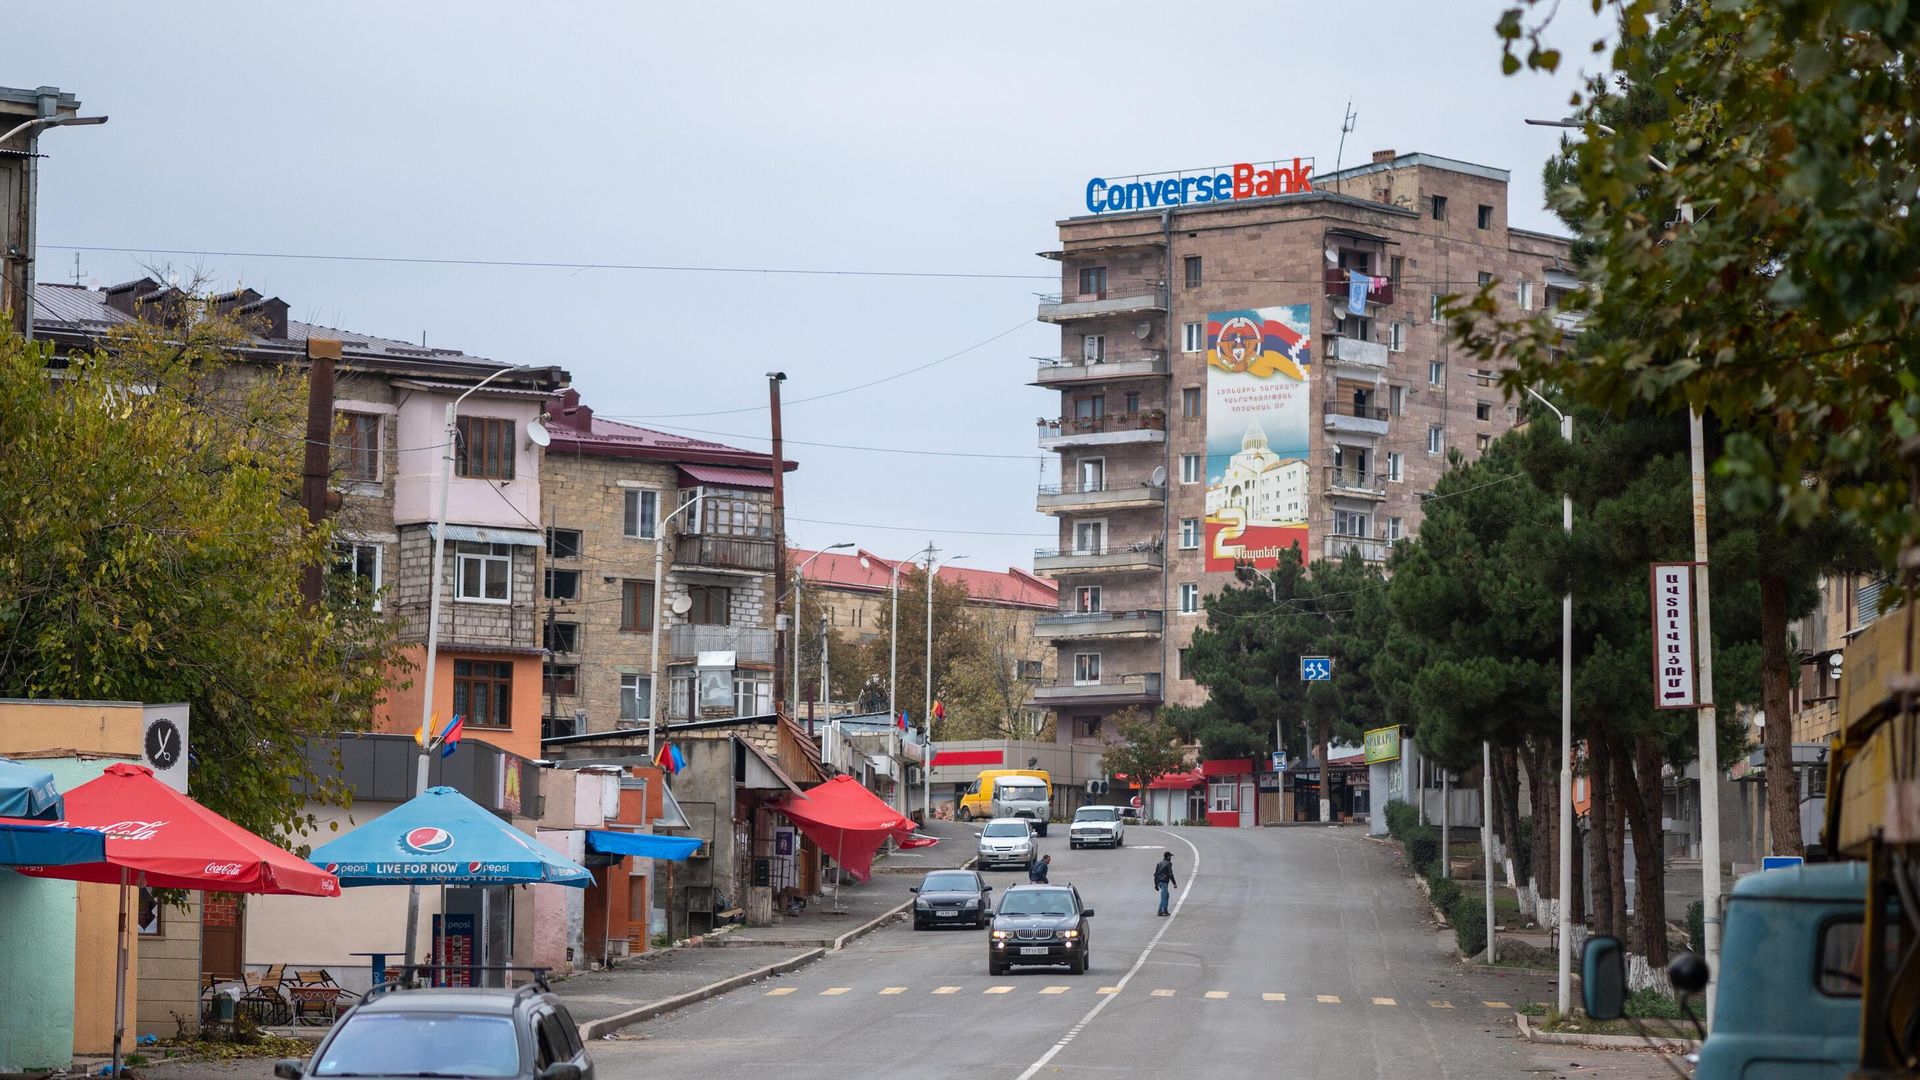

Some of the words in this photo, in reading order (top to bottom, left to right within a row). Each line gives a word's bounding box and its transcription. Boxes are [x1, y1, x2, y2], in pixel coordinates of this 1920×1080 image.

[1213, 507, 1247, 559] 2
[341, 863, 368, 874] pepsi
[376, 864, 401, 874] LIVE
[404, 864, 428, 874] FOR
[431, 863, 458, 873] NOW
[483, 863, 510, 874] pepsi
[448, 920, 471, 930] pepsi
